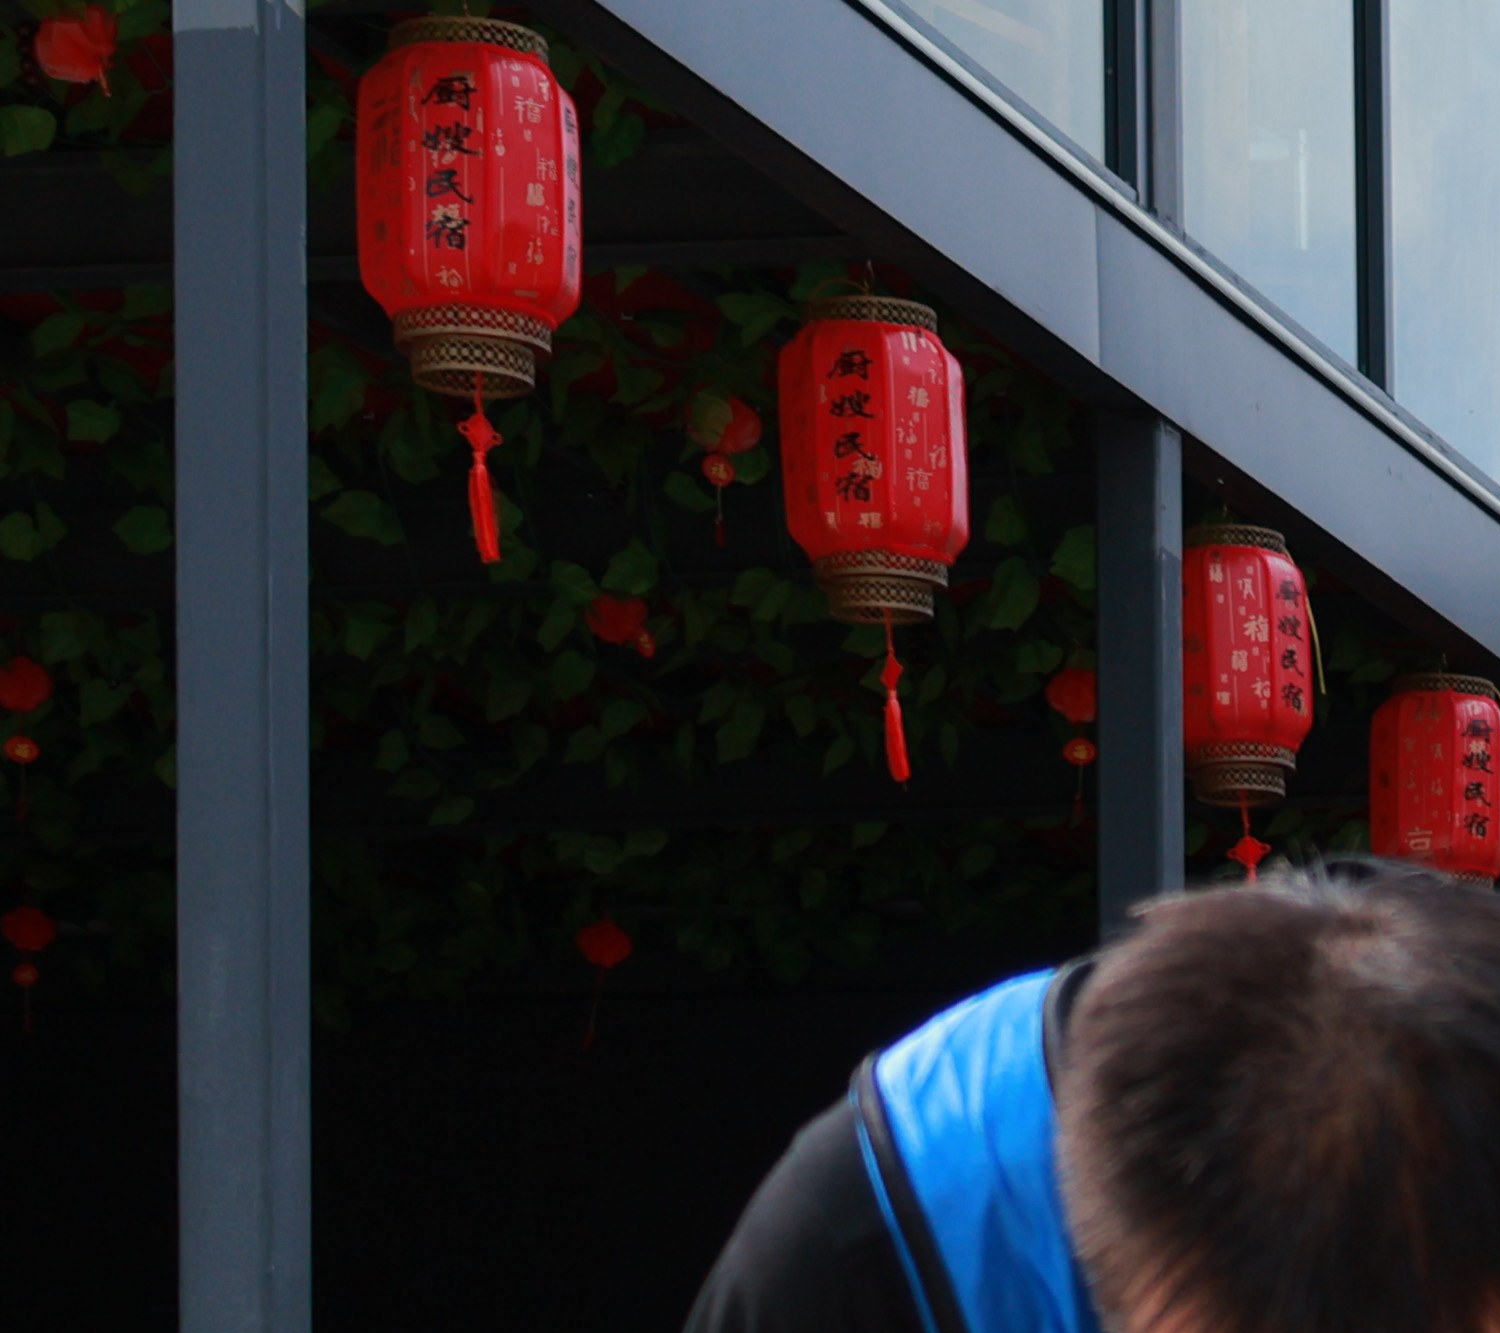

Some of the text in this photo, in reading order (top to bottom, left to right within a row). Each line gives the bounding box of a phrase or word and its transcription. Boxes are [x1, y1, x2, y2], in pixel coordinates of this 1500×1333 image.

[421, 76, 482, 250] 厨嫂民宿
[829, 350, 875, 501] 厨嫂民宿
[1277, 580, 1304, 711] 厨嫂民宿
[1461, 719, 1494, 840] 厨嫂民宿
